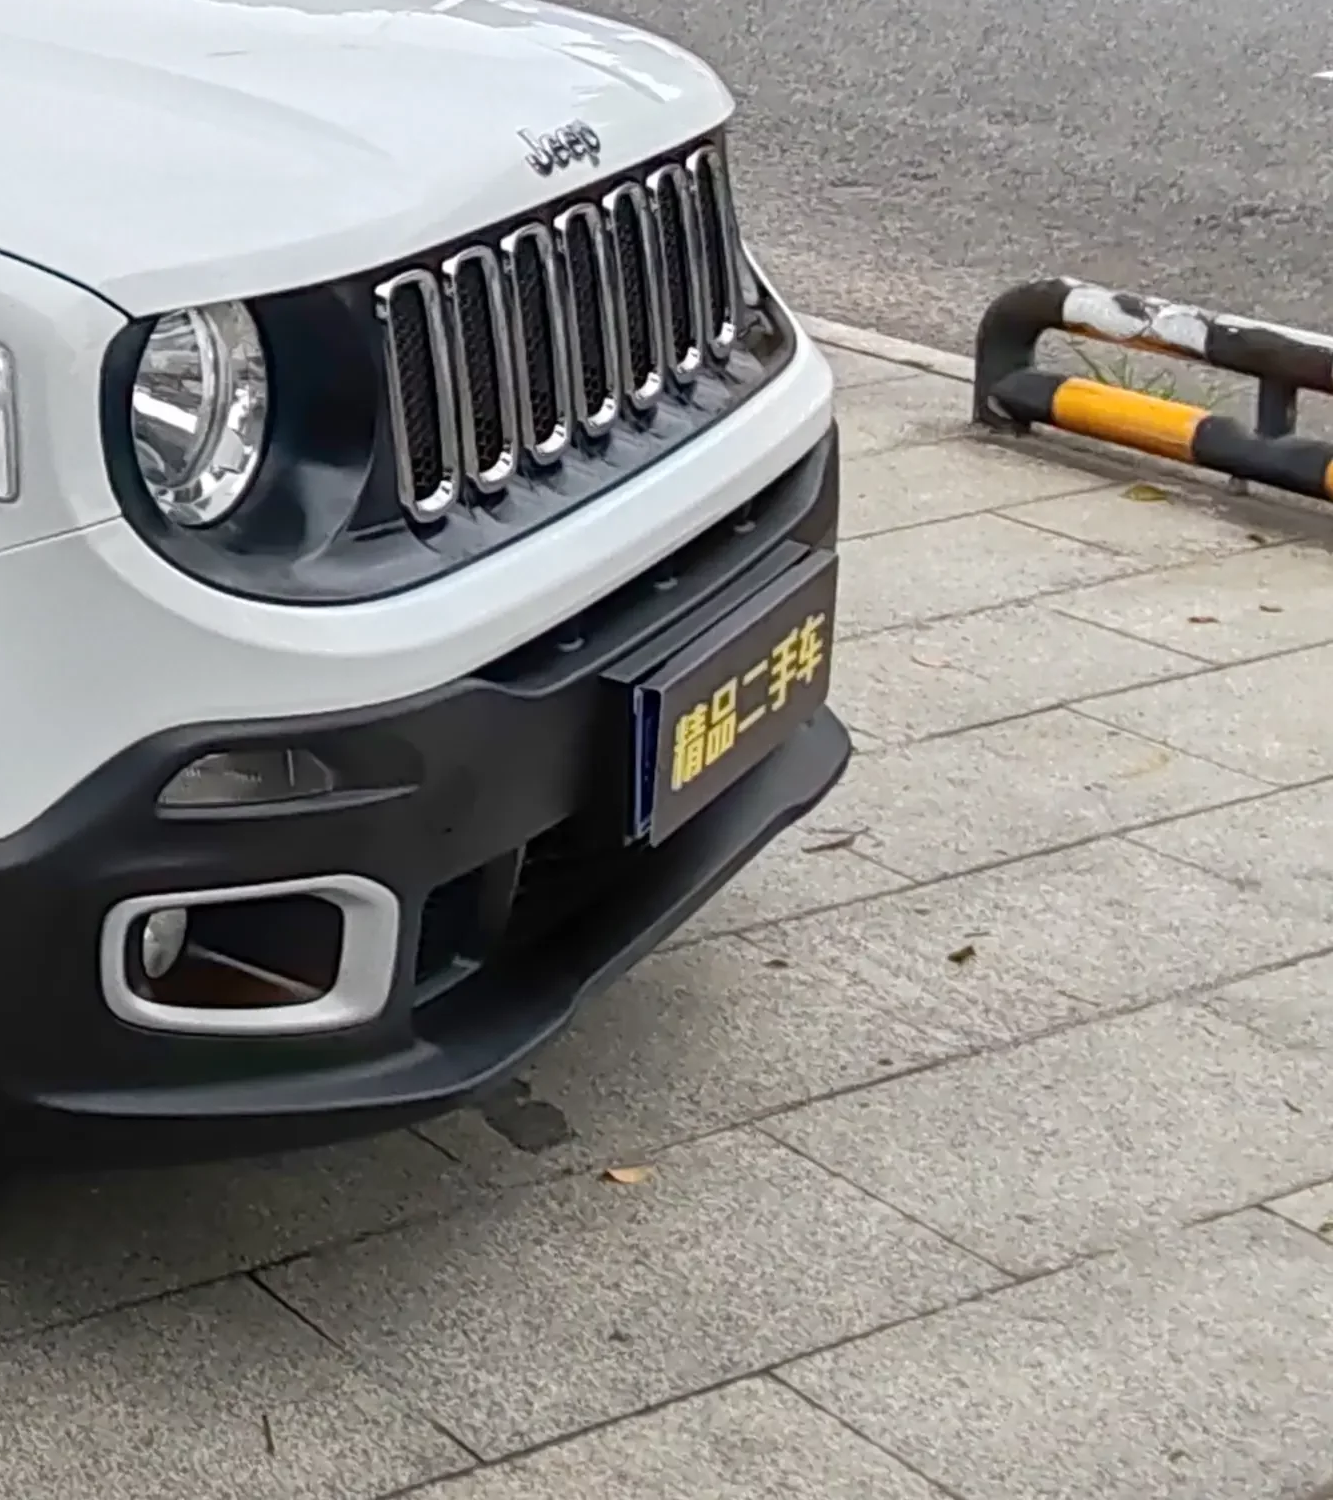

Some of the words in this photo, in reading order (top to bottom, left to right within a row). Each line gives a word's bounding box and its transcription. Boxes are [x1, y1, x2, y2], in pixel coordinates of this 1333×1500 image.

[517, 118, 601, 178] Jeep
[671, 612, 826, 792] 精品二手车
